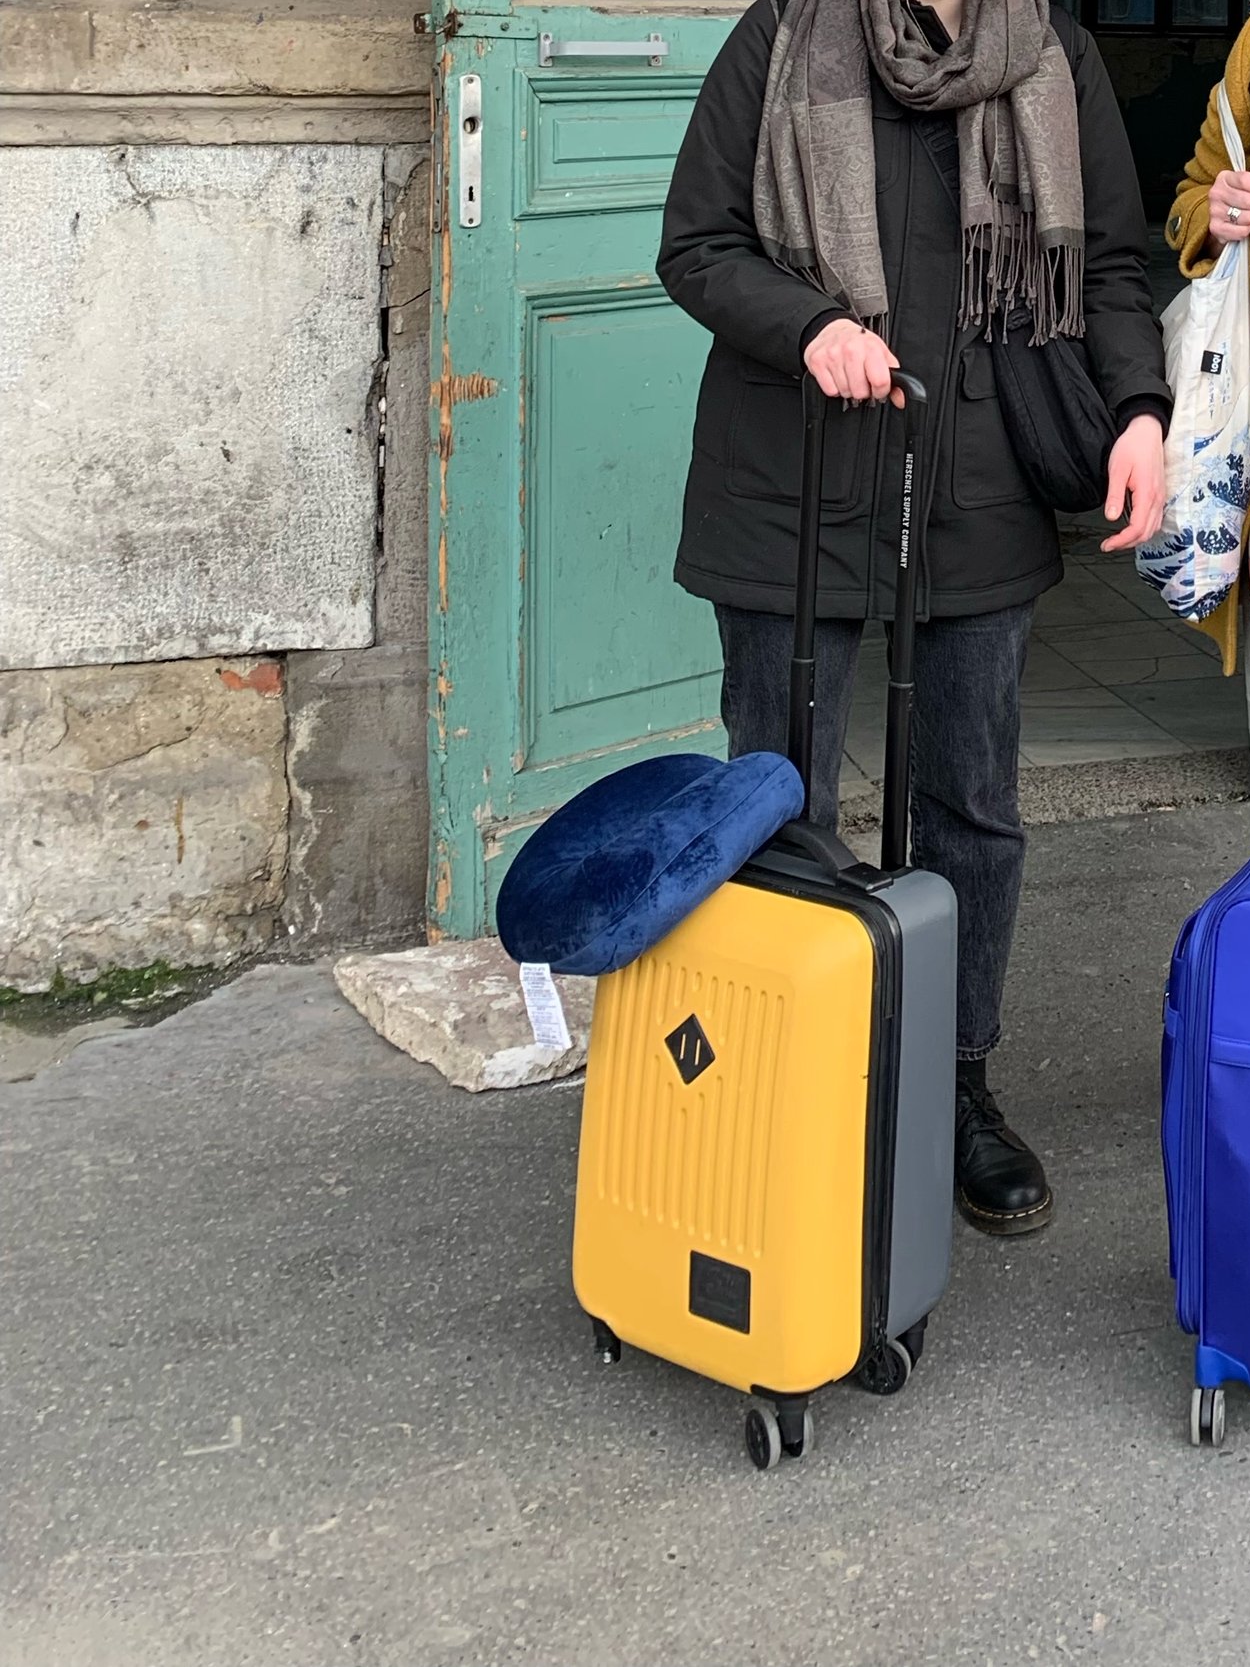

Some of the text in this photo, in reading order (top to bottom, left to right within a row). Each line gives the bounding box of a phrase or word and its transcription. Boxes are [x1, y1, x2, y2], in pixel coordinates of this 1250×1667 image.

[900, 453, 913, 569] HERSCHEL SUPPLY COMPANY
